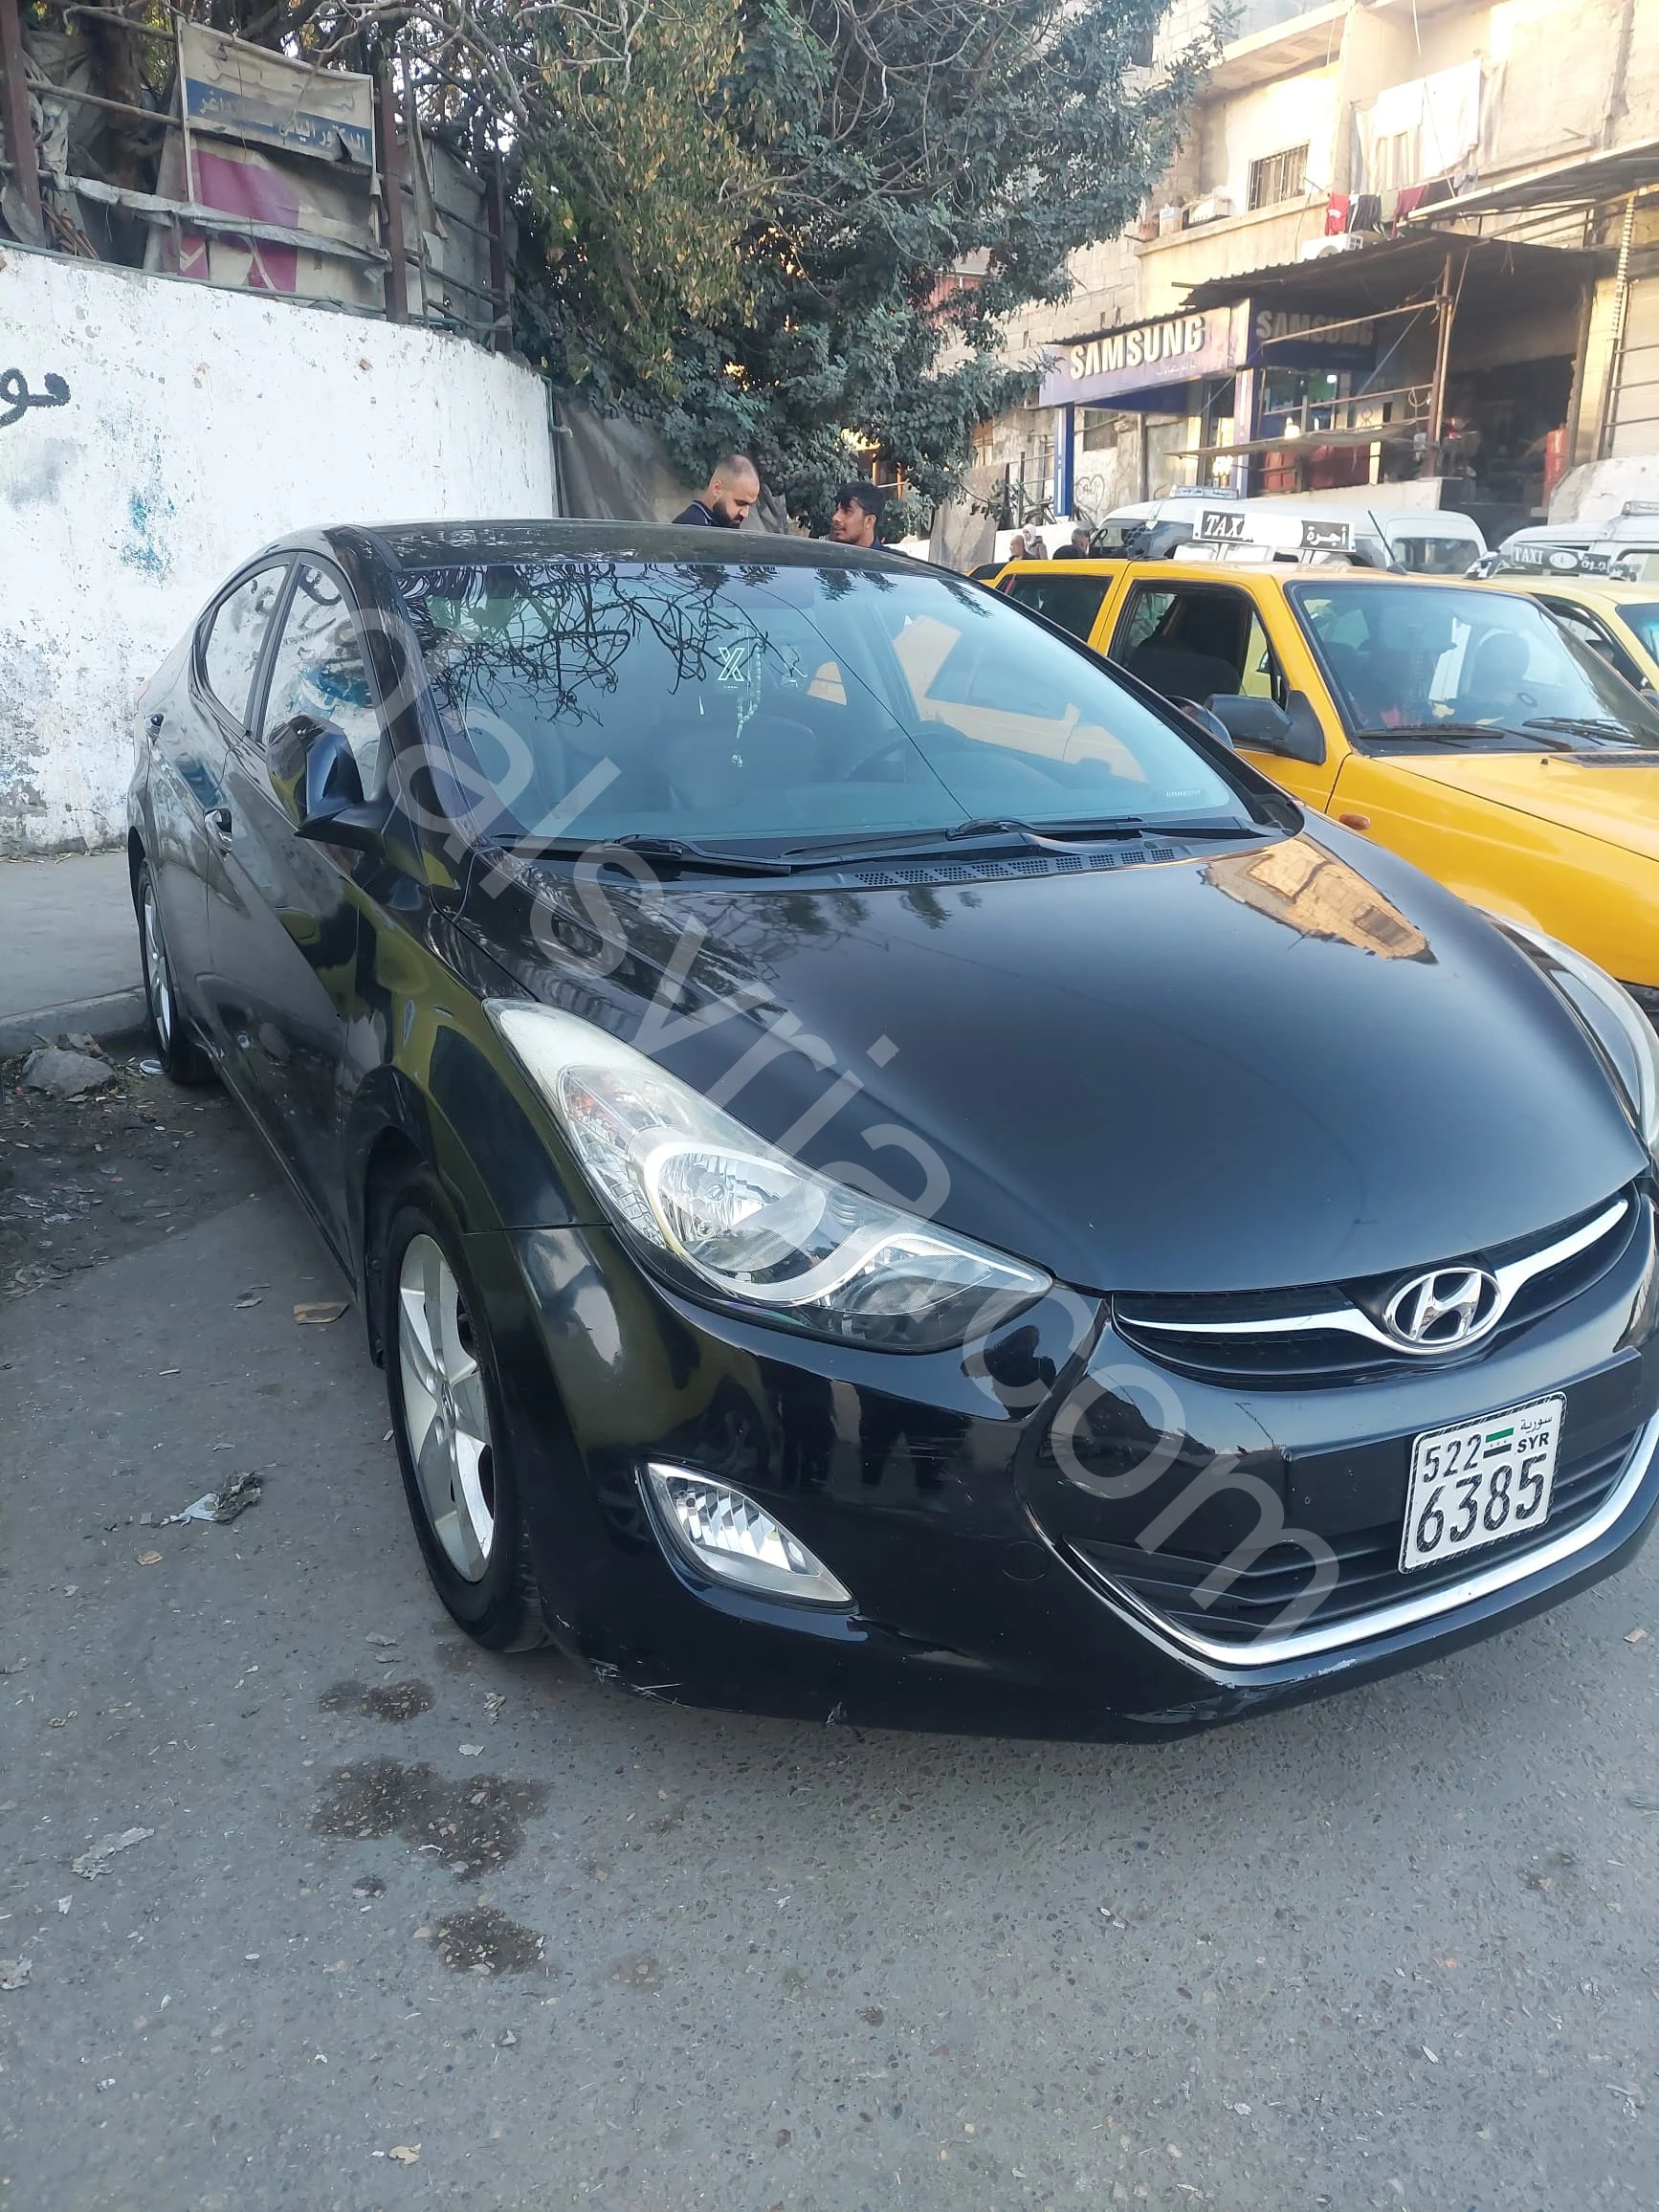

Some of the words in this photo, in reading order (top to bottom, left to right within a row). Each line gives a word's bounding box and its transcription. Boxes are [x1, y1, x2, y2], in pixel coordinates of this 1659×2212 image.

[1256, 310, 1374, 345] SAMSUNG
[1070, 317, 1205, 380] SAMSUNG
[1306, 526, 1347, 547] أجرة
[1514, 546, 1544, 565] TAXI
[1520, 1416, 1553, 1434] سورية
[1516, 1432, 1550, 1454] SYR
[1422, 1433, 1482, 1483] 522
[1416, 1452, 1547, 1553] 6385
